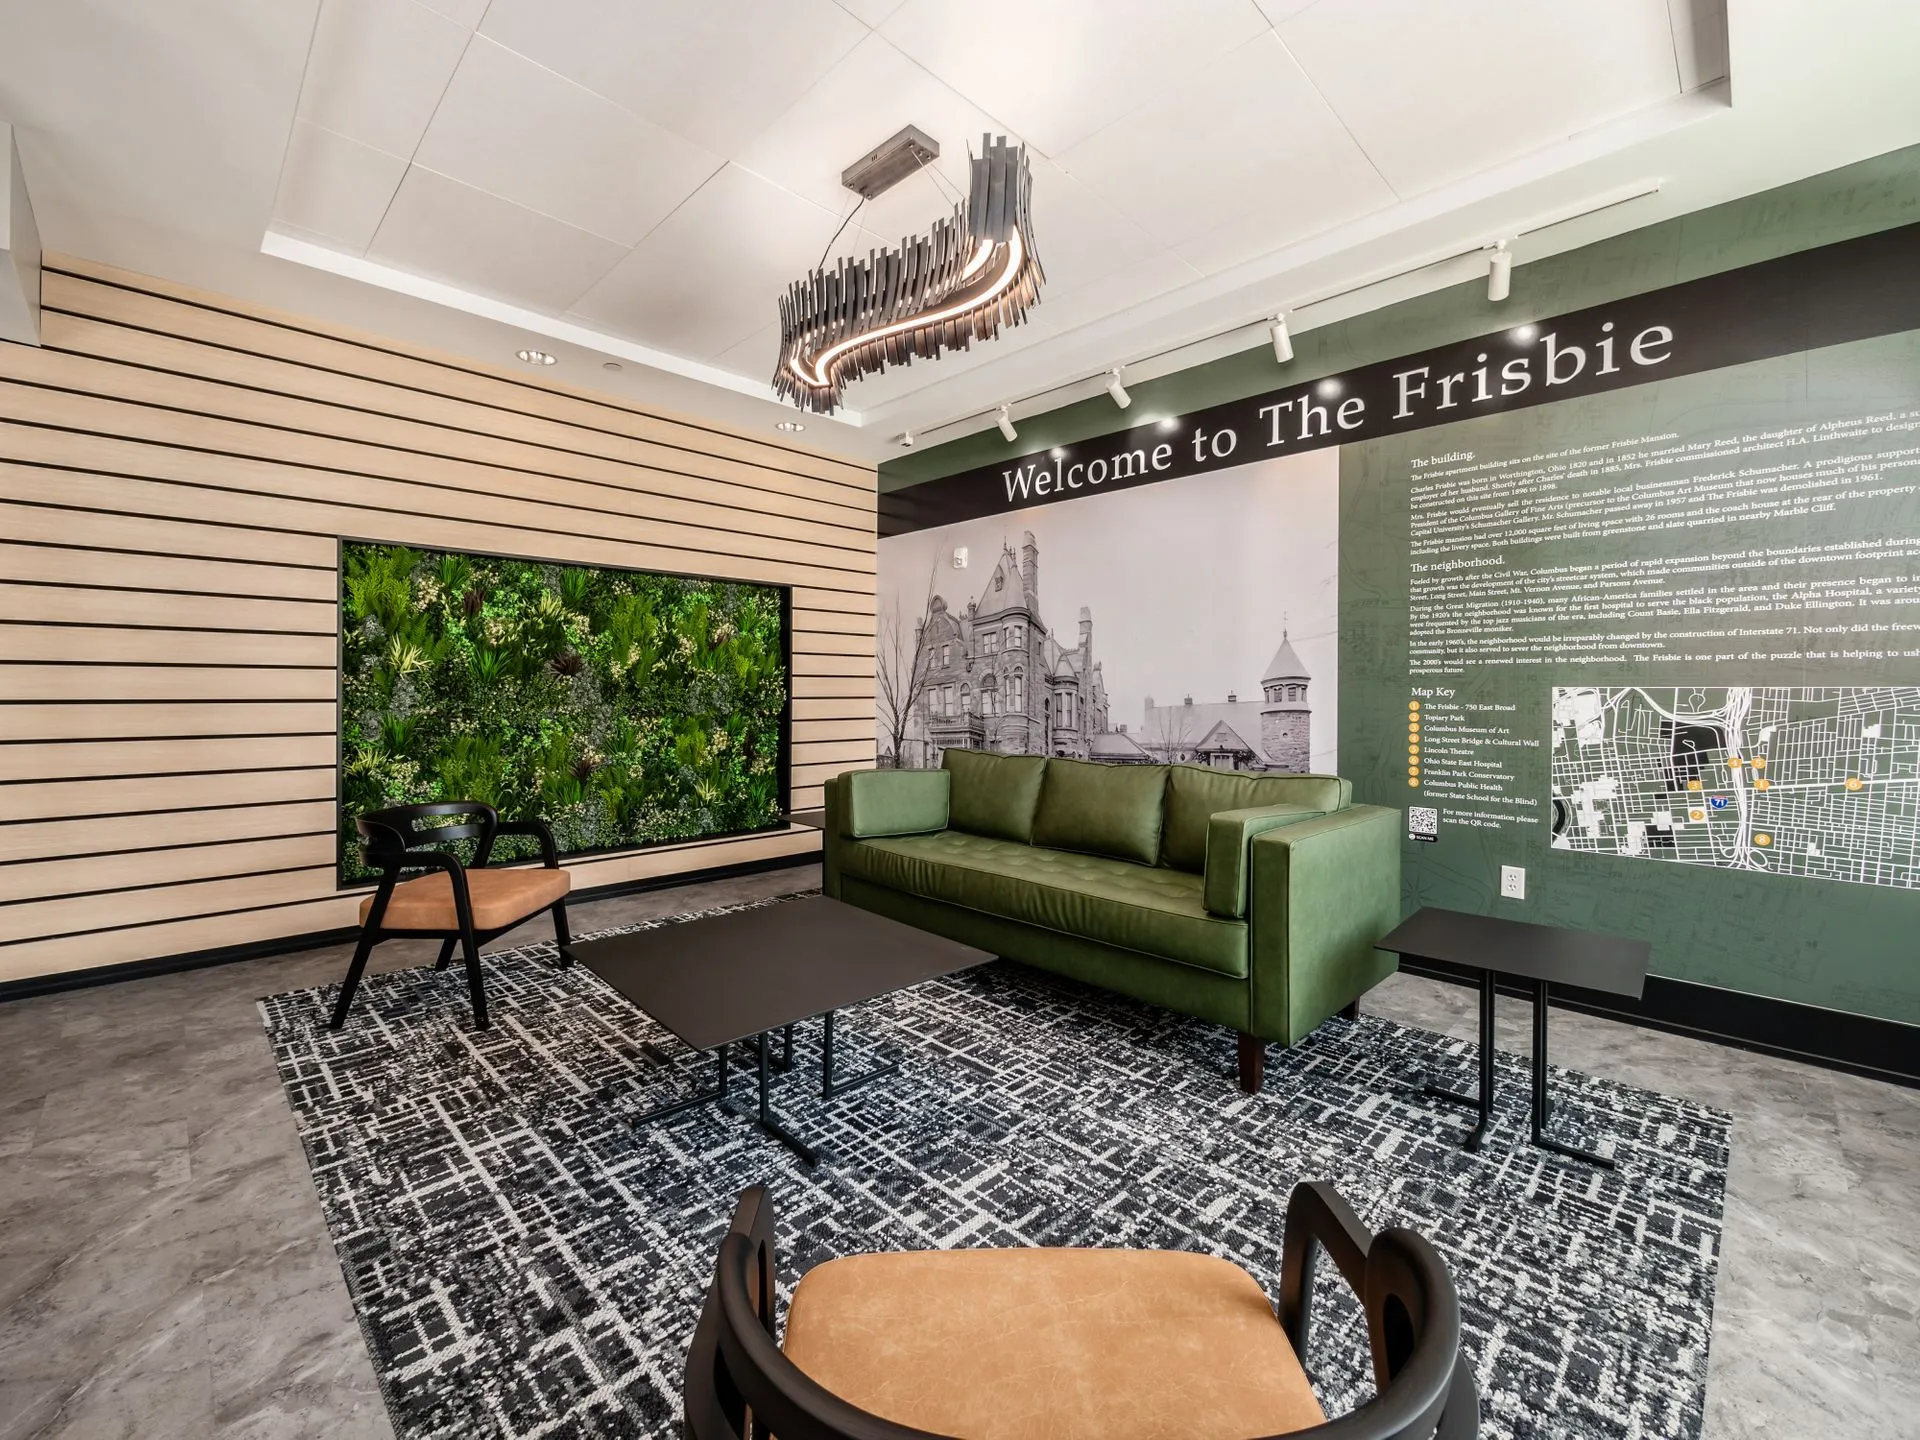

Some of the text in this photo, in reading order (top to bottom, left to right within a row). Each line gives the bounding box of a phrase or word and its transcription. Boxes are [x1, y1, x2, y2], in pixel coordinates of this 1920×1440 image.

[1002, 321, 1673, 502] Welcome to The Frisbie
[1410, 451, 1475, 468] The building.
[1423, 470, 1444, 479] Frisbie
[1444, 467, 1478, 476] apartment
[1479, 460, 1507, 469] building
[1582, 444, 1610, 453] former
[1611, 438, 1639, 448] Frisbie
[1418, 500, 1455, 508] constructed
[1511, 486, 1528, 495] 1896
[1410, 528, 1432, 536] Capital
[1470, 519, 1512, 529] Schumacher
[1555, 508, 1603, 518] Schumacher
[1604, 503, 1630, 514] passed
[1666, 496, 1686, 505] 1957
[1687, 493, 1705, 502] and
[1706, 492, 1724, 500] The
[1725, 488, 1758, 498] Frisbie
[1779, 480, 1839, 491] demolished
[1410, 547, 1439, 555] including
[1509, 535, 1543, 544] buildings
[1562, 530, 1580, 539] built
[1581, 528, 1601, 537] from
[1602, 525, 1646, 536] greenstone
[1647, 521, 1664, 530] and
[1686, 514, 1725, 527] quarried
[1738, 510, 1771, 520] nearby
[1773, 506, 1809, 516] Marble
[1410, 554, 1505, 572] The neighborhood.
[1543, 642, 1596, 652] neighborhood
[1411, 687, 1456, 699] Map Key
[1423, 714, 1448, 722] Topiary
[1424, 735, 1440, 744] Long
[1461, 737, 1483, 746] Bridge
[1473, 760, 1502, 769] Hospital
[1423, 779, 1456, 787] Columbus
[1468, 771, 1515, 781] Conservatory
[1423, 790, 1448, 798] (former
[1465, 793, 1489, 801] School
[1514, 797, 1537, 806] Blind)
[1473, 811, 1515, 820] information
[1516, 815, 1538, 823] please
